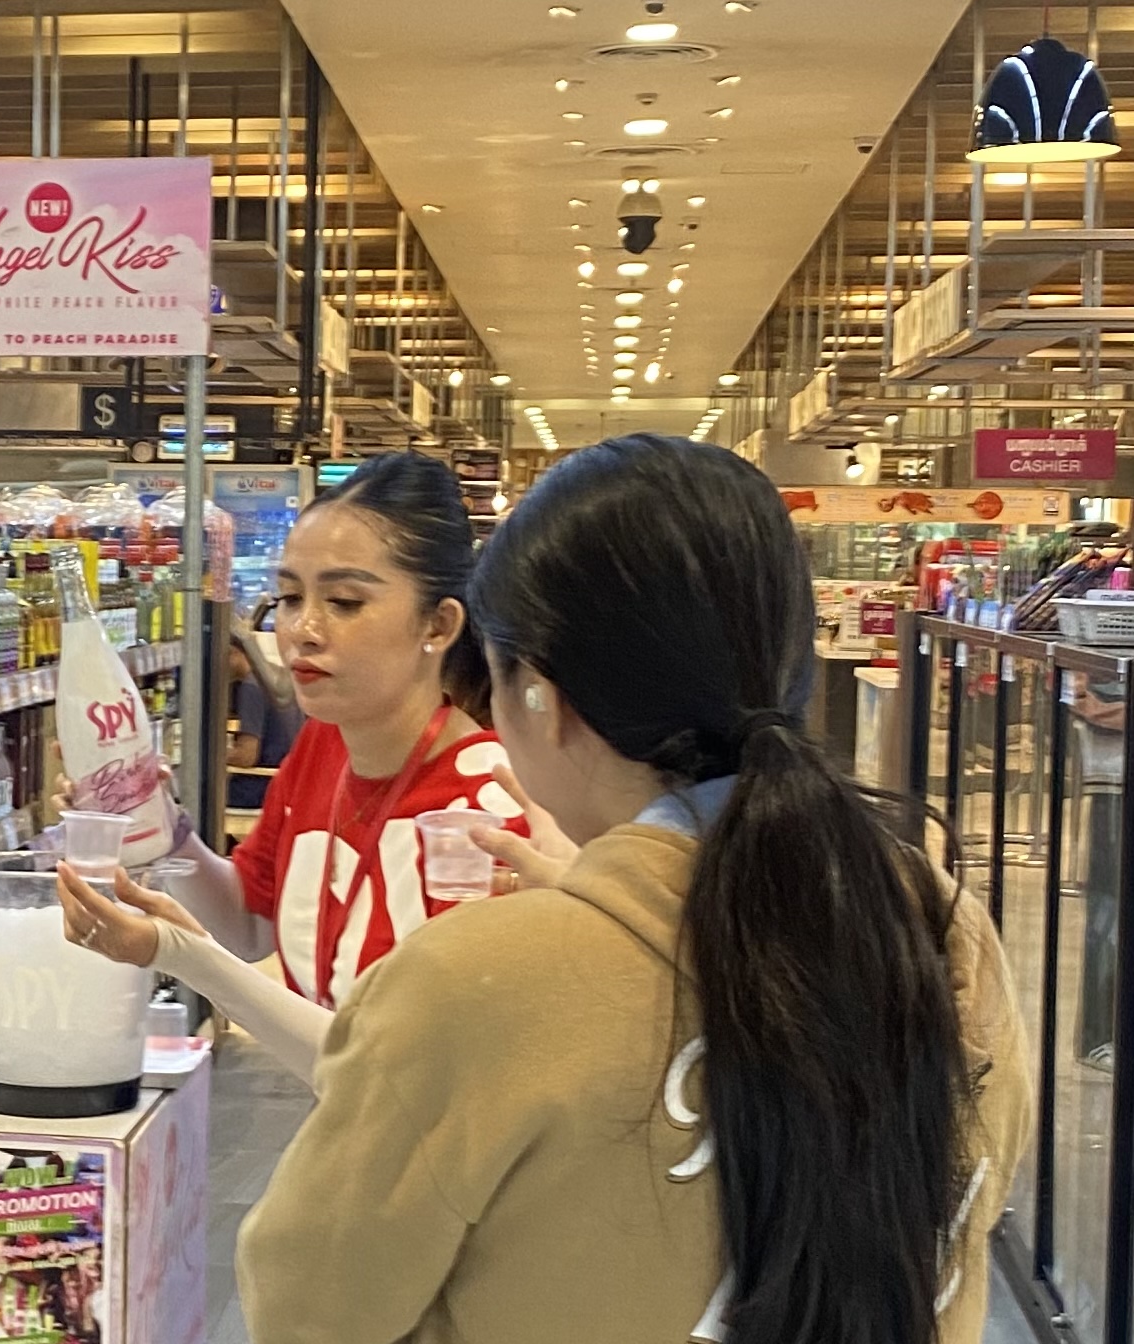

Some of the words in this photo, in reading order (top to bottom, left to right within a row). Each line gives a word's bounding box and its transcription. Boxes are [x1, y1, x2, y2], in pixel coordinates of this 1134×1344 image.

[29, 199, 68, 217] NEW!
[58, 206, 180, 294] Kiss
[52, 296, 105, 308] PEACH
[5, 334, 25, 345] TO
[32, 334, 88, 345] PEACH
[94, 334, 179, 345] PARADISE
[93, 393, 116, 429] $
[1009, 459, 1082, 472] CASHIER
[86, 688, 138, 740] SPY
